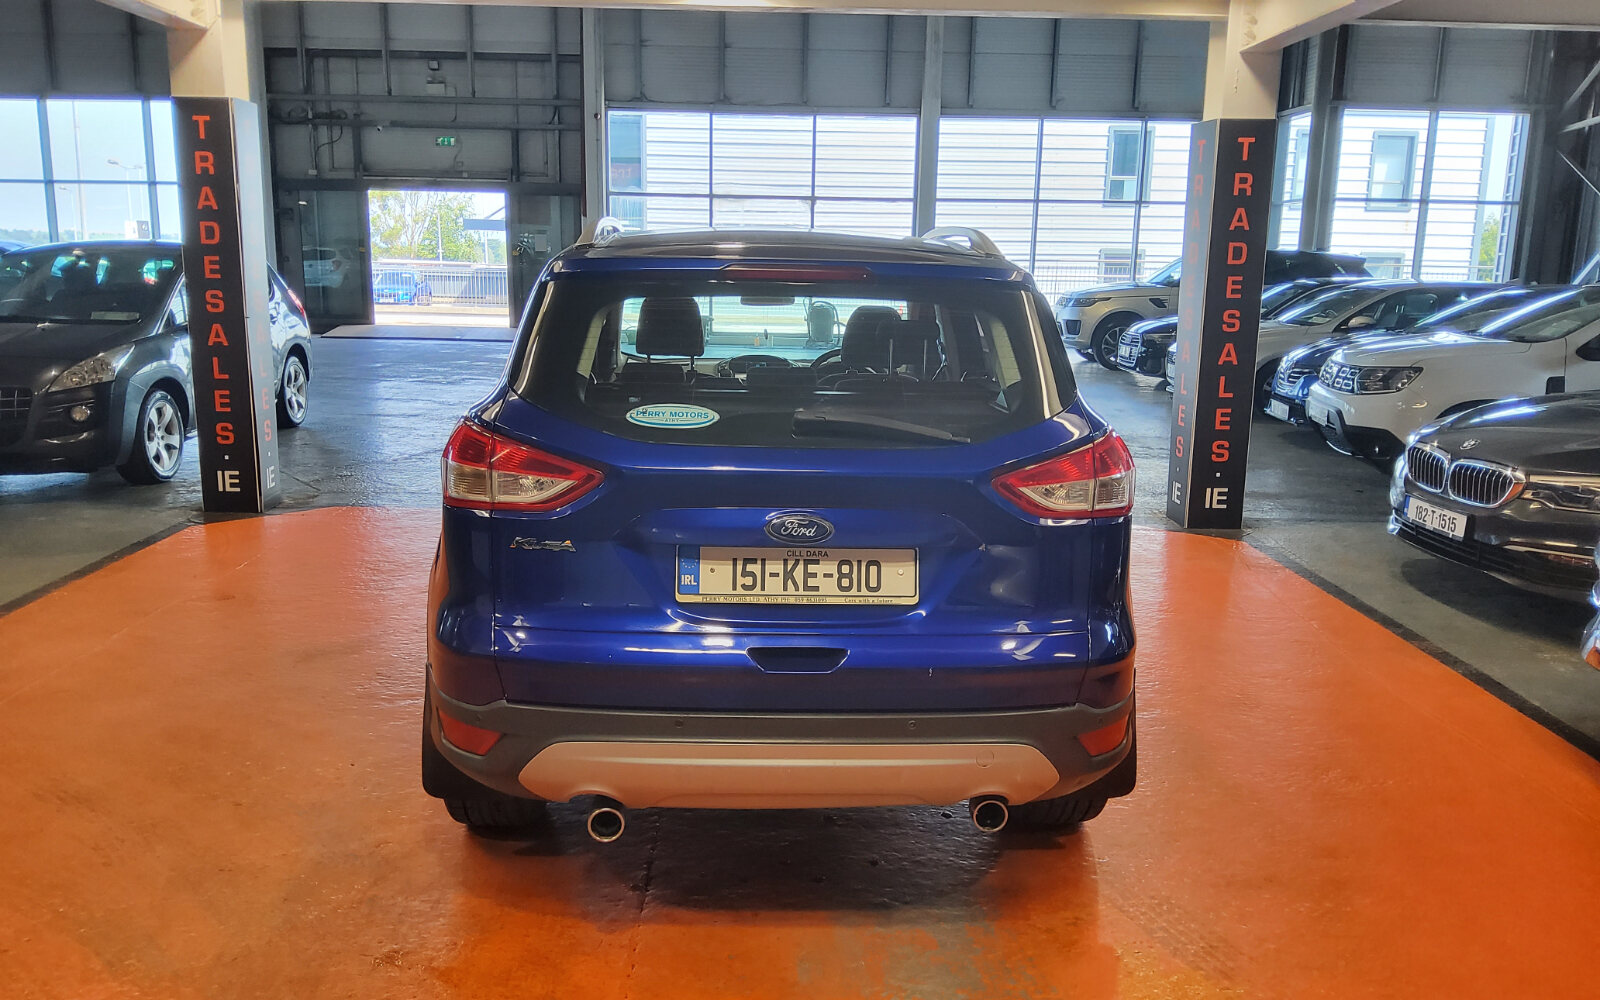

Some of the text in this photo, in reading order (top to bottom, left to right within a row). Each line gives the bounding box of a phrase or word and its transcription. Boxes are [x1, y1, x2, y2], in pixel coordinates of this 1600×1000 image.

[670, 411, 709, 419] MOTORS
[780, 518, 817, 537] Ford
[786, 550, 829, 558] CILL DARA
[681, 575, 697, 585] IRL
[731, 557, 882, 593] 151-KE-810
